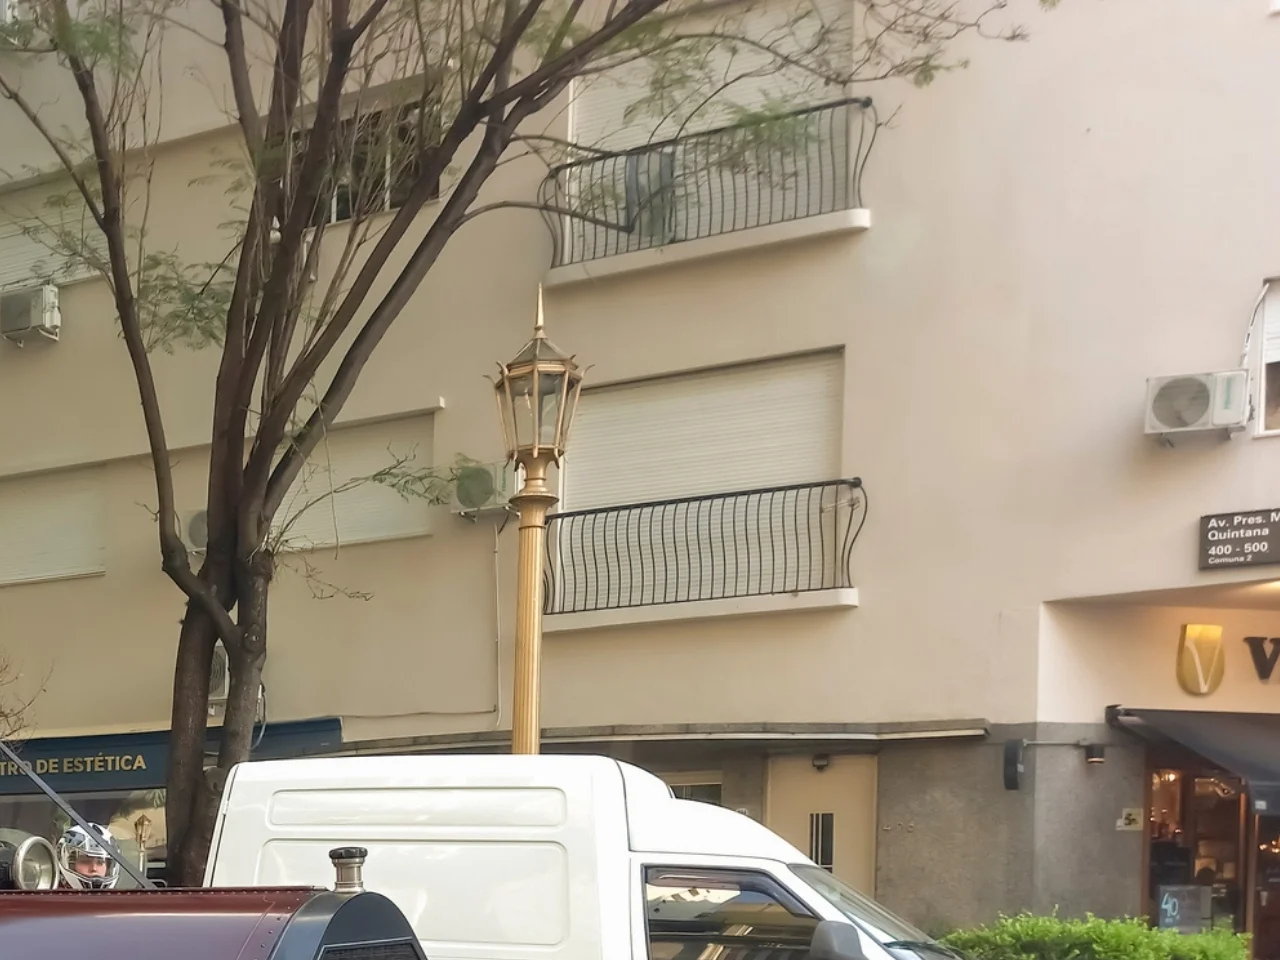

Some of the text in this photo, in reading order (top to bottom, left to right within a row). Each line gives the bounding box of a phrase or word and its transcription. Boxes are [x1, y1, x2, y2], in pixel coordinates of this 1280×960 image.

[1207, 518, 1229, 529] Av.
[1233, 515, 1266, 526] Pres.
[1207, 528, 1269, 541] Quintana
[1207, 545, 1233, 556] 400
[1244, 541, 1268, 553] 500
[1208, 556, 1245, 565] Comuna
[35, 758, 59, 775] DE
[62, 751, 147, 774] ESTÉTICA
